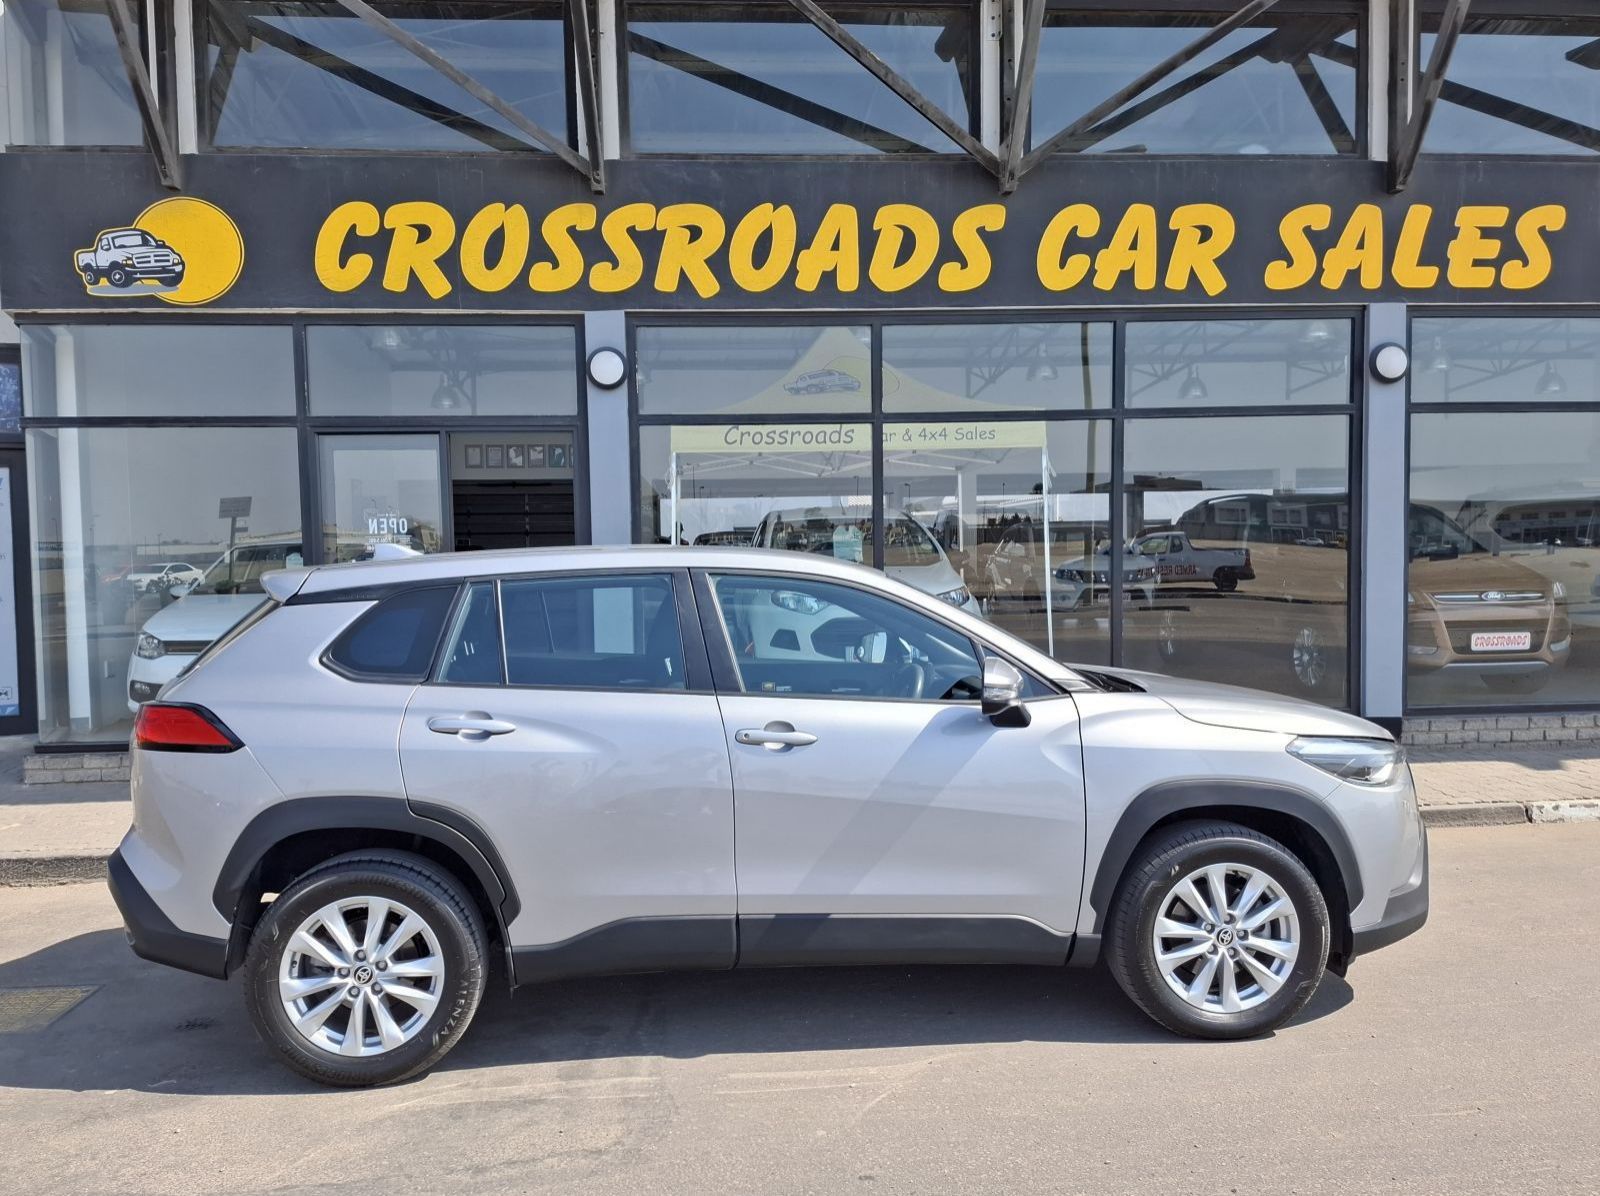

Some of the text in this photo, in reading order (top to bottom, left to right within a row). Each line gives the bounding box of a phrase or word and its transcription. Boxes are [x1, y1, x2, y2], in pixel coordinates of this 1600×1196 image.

[316, 202, 1566, 298] CROSSROADS CAR SALES
[723, 425, 855, 446] Crossroads
[902, 428, 913, 442] &
[918, 426, 948, 442] 4x4
[954, 425, 996, 441] Sales
[1474, 635, 1528, 648] CROSSROADS
